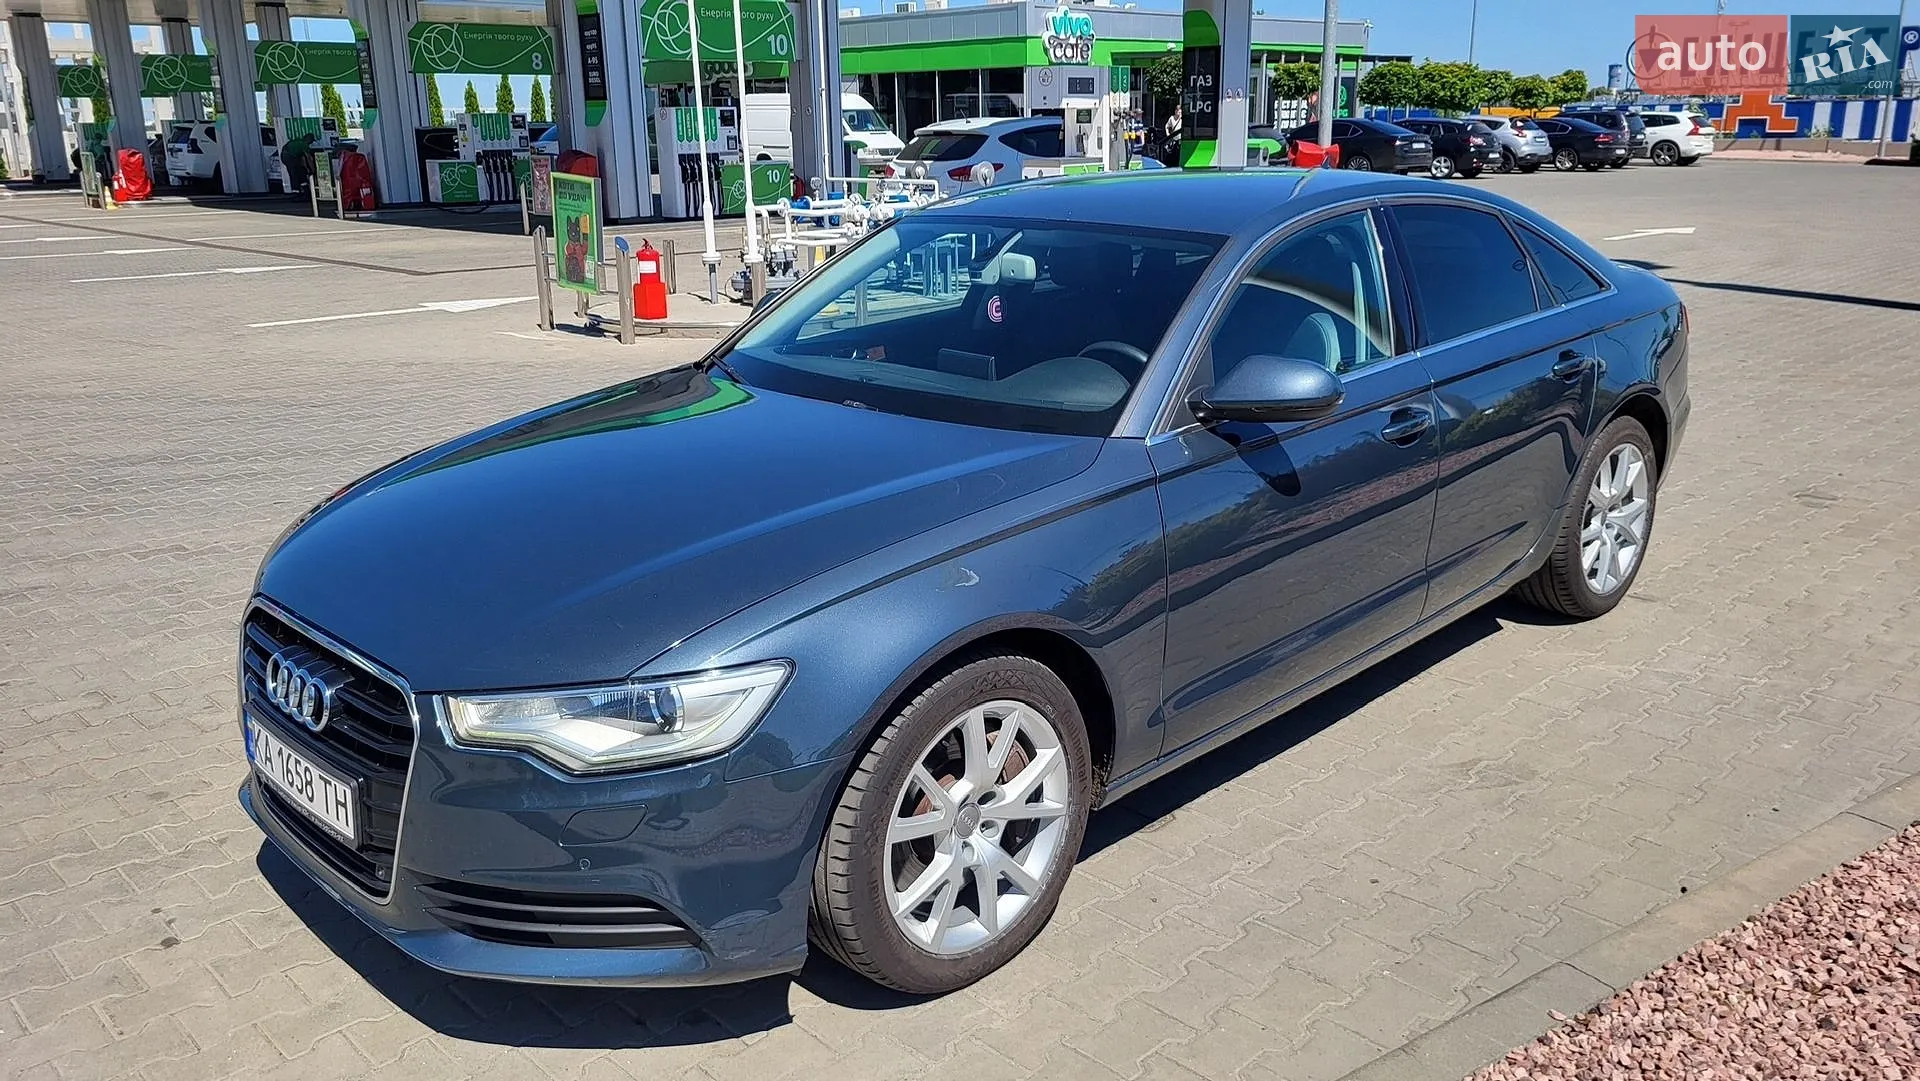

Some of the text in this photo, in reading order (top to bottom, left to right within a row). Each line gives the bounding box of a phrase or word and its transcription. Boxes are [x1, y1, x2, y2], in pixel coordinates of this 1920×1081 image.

[700, 7, 732, 19] Енергія
[756, 11, 774, 21] руху
[1052, 9, 1092, 37] vivo
[463, 31, 534, 44] Енергія твого руху
[767, 34, 788, 56] 10
[532, 52, 543, 71] 8
[1190, 75, 1213, 88] ГАЗ
[1189, 101, 1212, 113] LPG
[766, 169, 780, 183] 10
[254, 728, 275, 774] KA
[277, 746, 315, 803] 1658
[318, 773, 350, 828] TH
